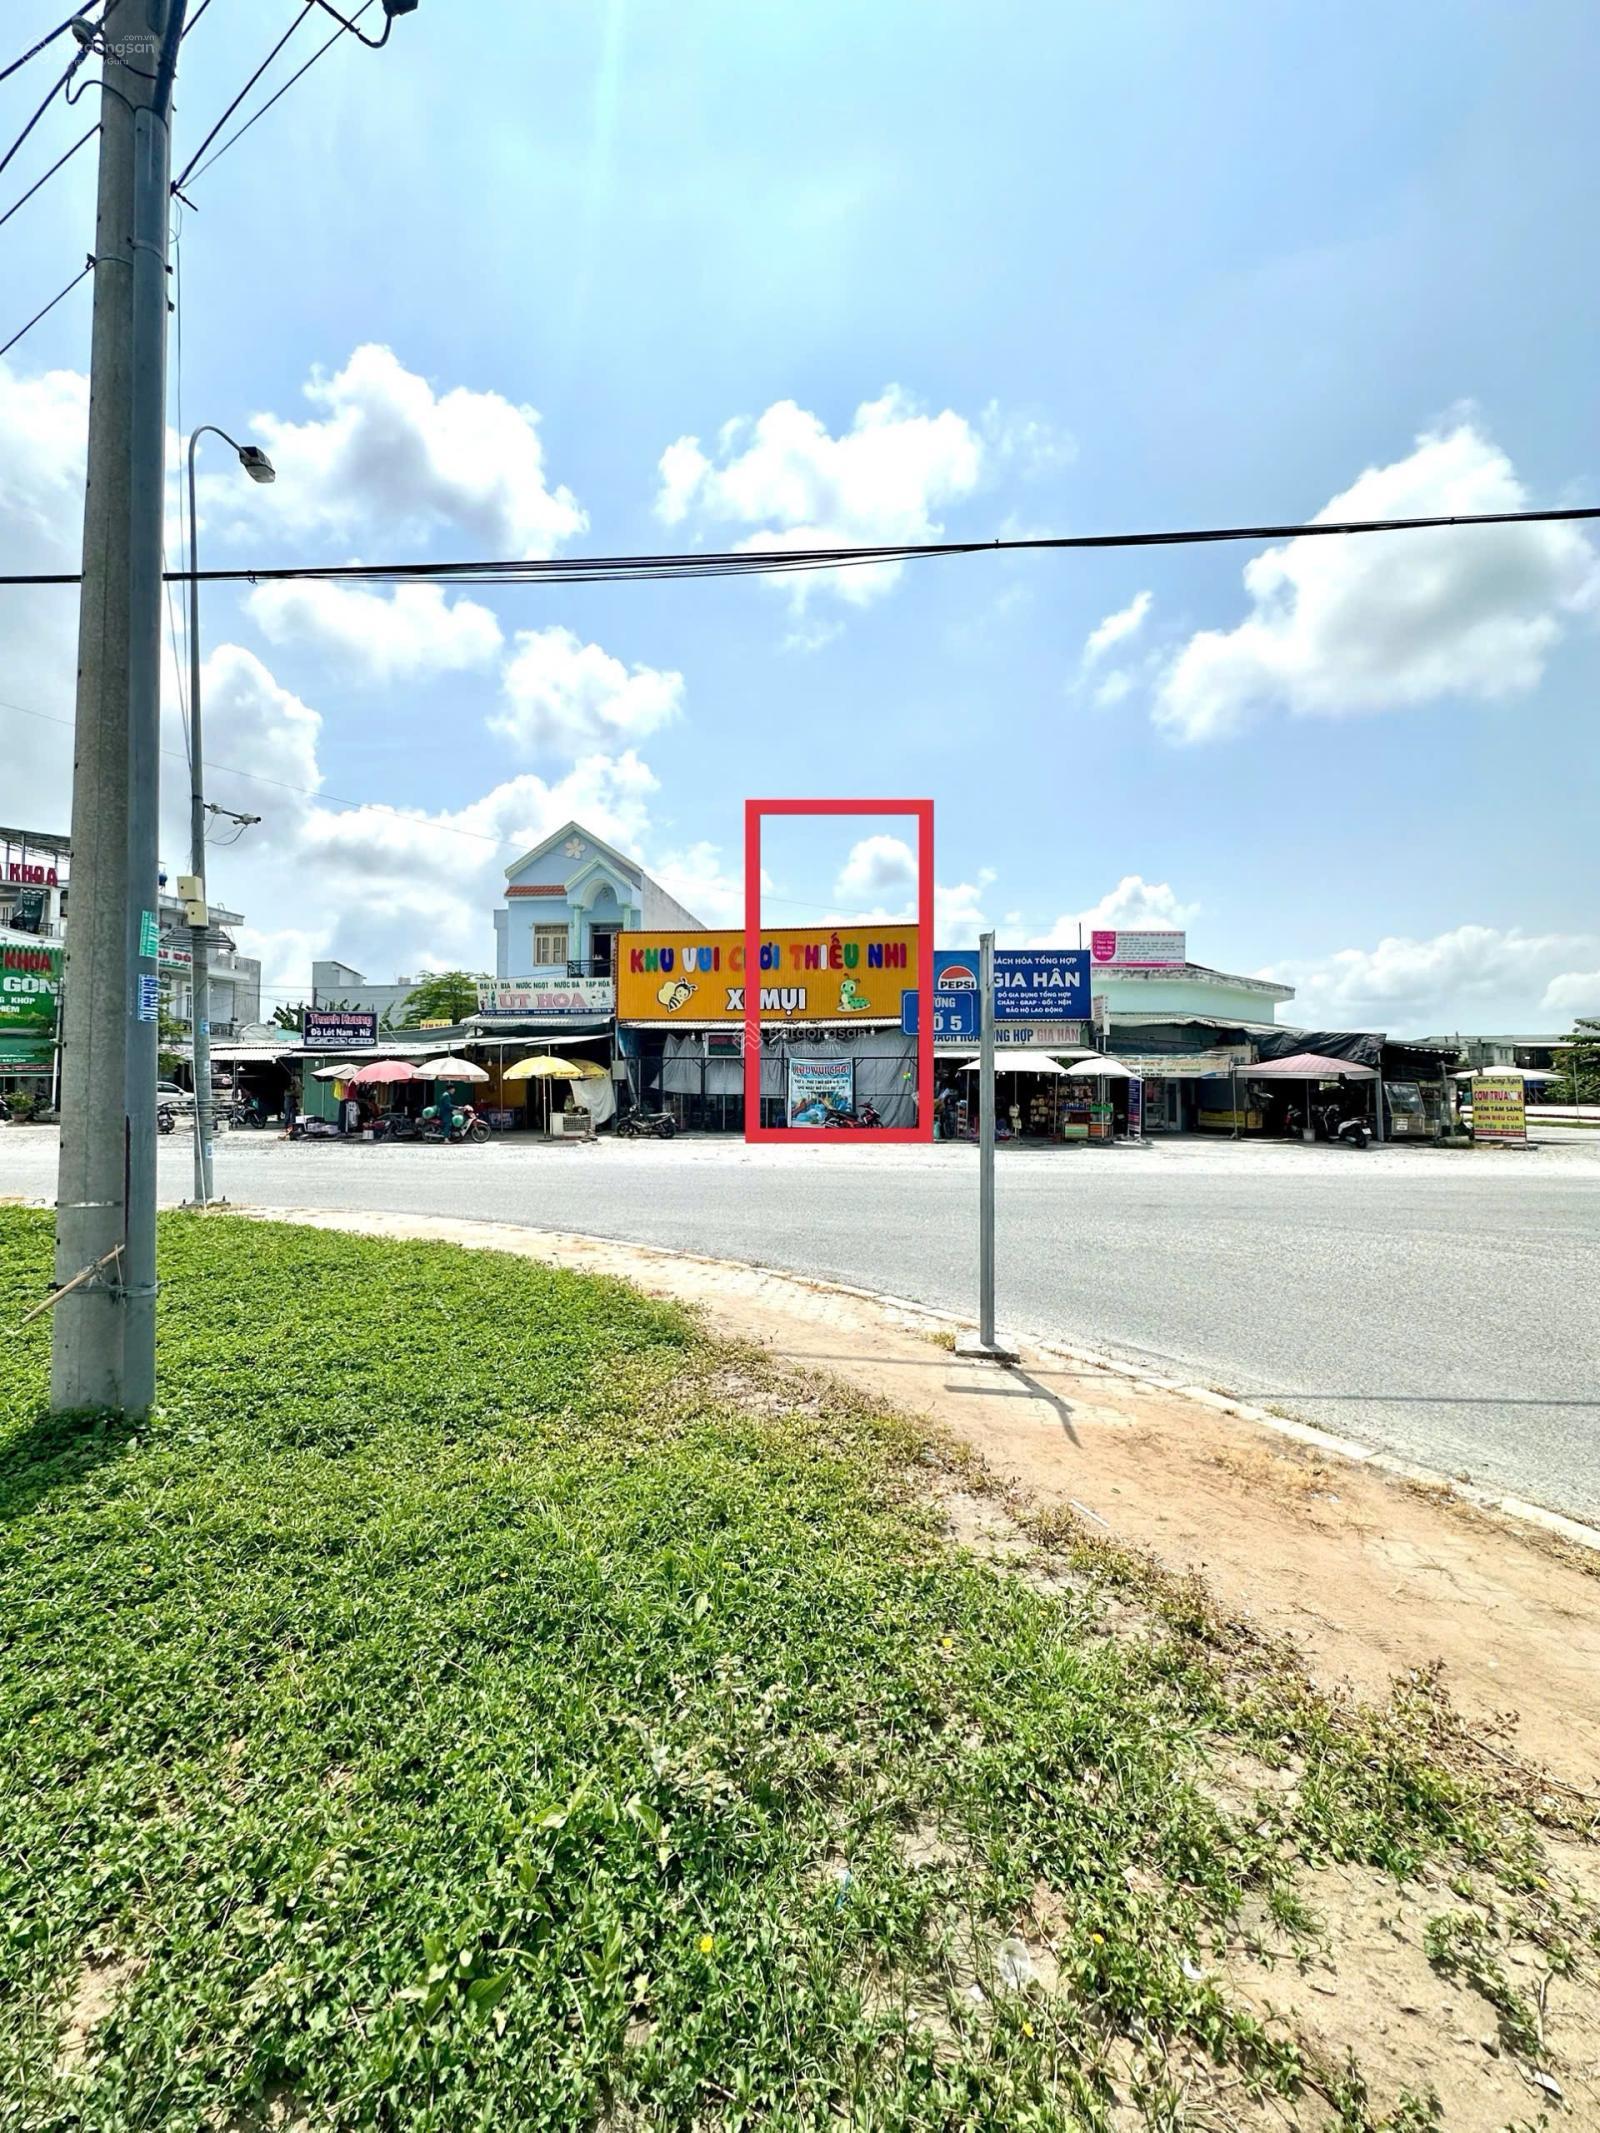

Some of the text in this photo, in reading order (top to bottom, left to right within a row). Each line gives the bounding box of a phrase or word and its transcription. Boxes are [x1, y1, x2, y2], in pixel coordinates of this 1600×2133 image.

[10, 863, 58, 886] KHOA
[4, 952, 52, 970] KHOA
[631, 932, 907, 973] KHU VUI CƠI THIẾU NHI
[1015, 956, 1032, 965] HÓA
[1034, 954, 1058, 964] TỔNG
[1060, 957, 1077, 965] HỢP
[3, 974, 58, 994] GÒN
[940, 981, 975, 989] PEPSI
[994, 967, 1081, 988] GIA HÂN
[933, 996, 956, 1008] ỜNG
[950, 1015, 963, 1031] 5
[336, 1028, 353, 1036] Nam
[1014, 1028, 1034, 1045] HỢP
[1037, 1030, 1055, 1042] GIA
